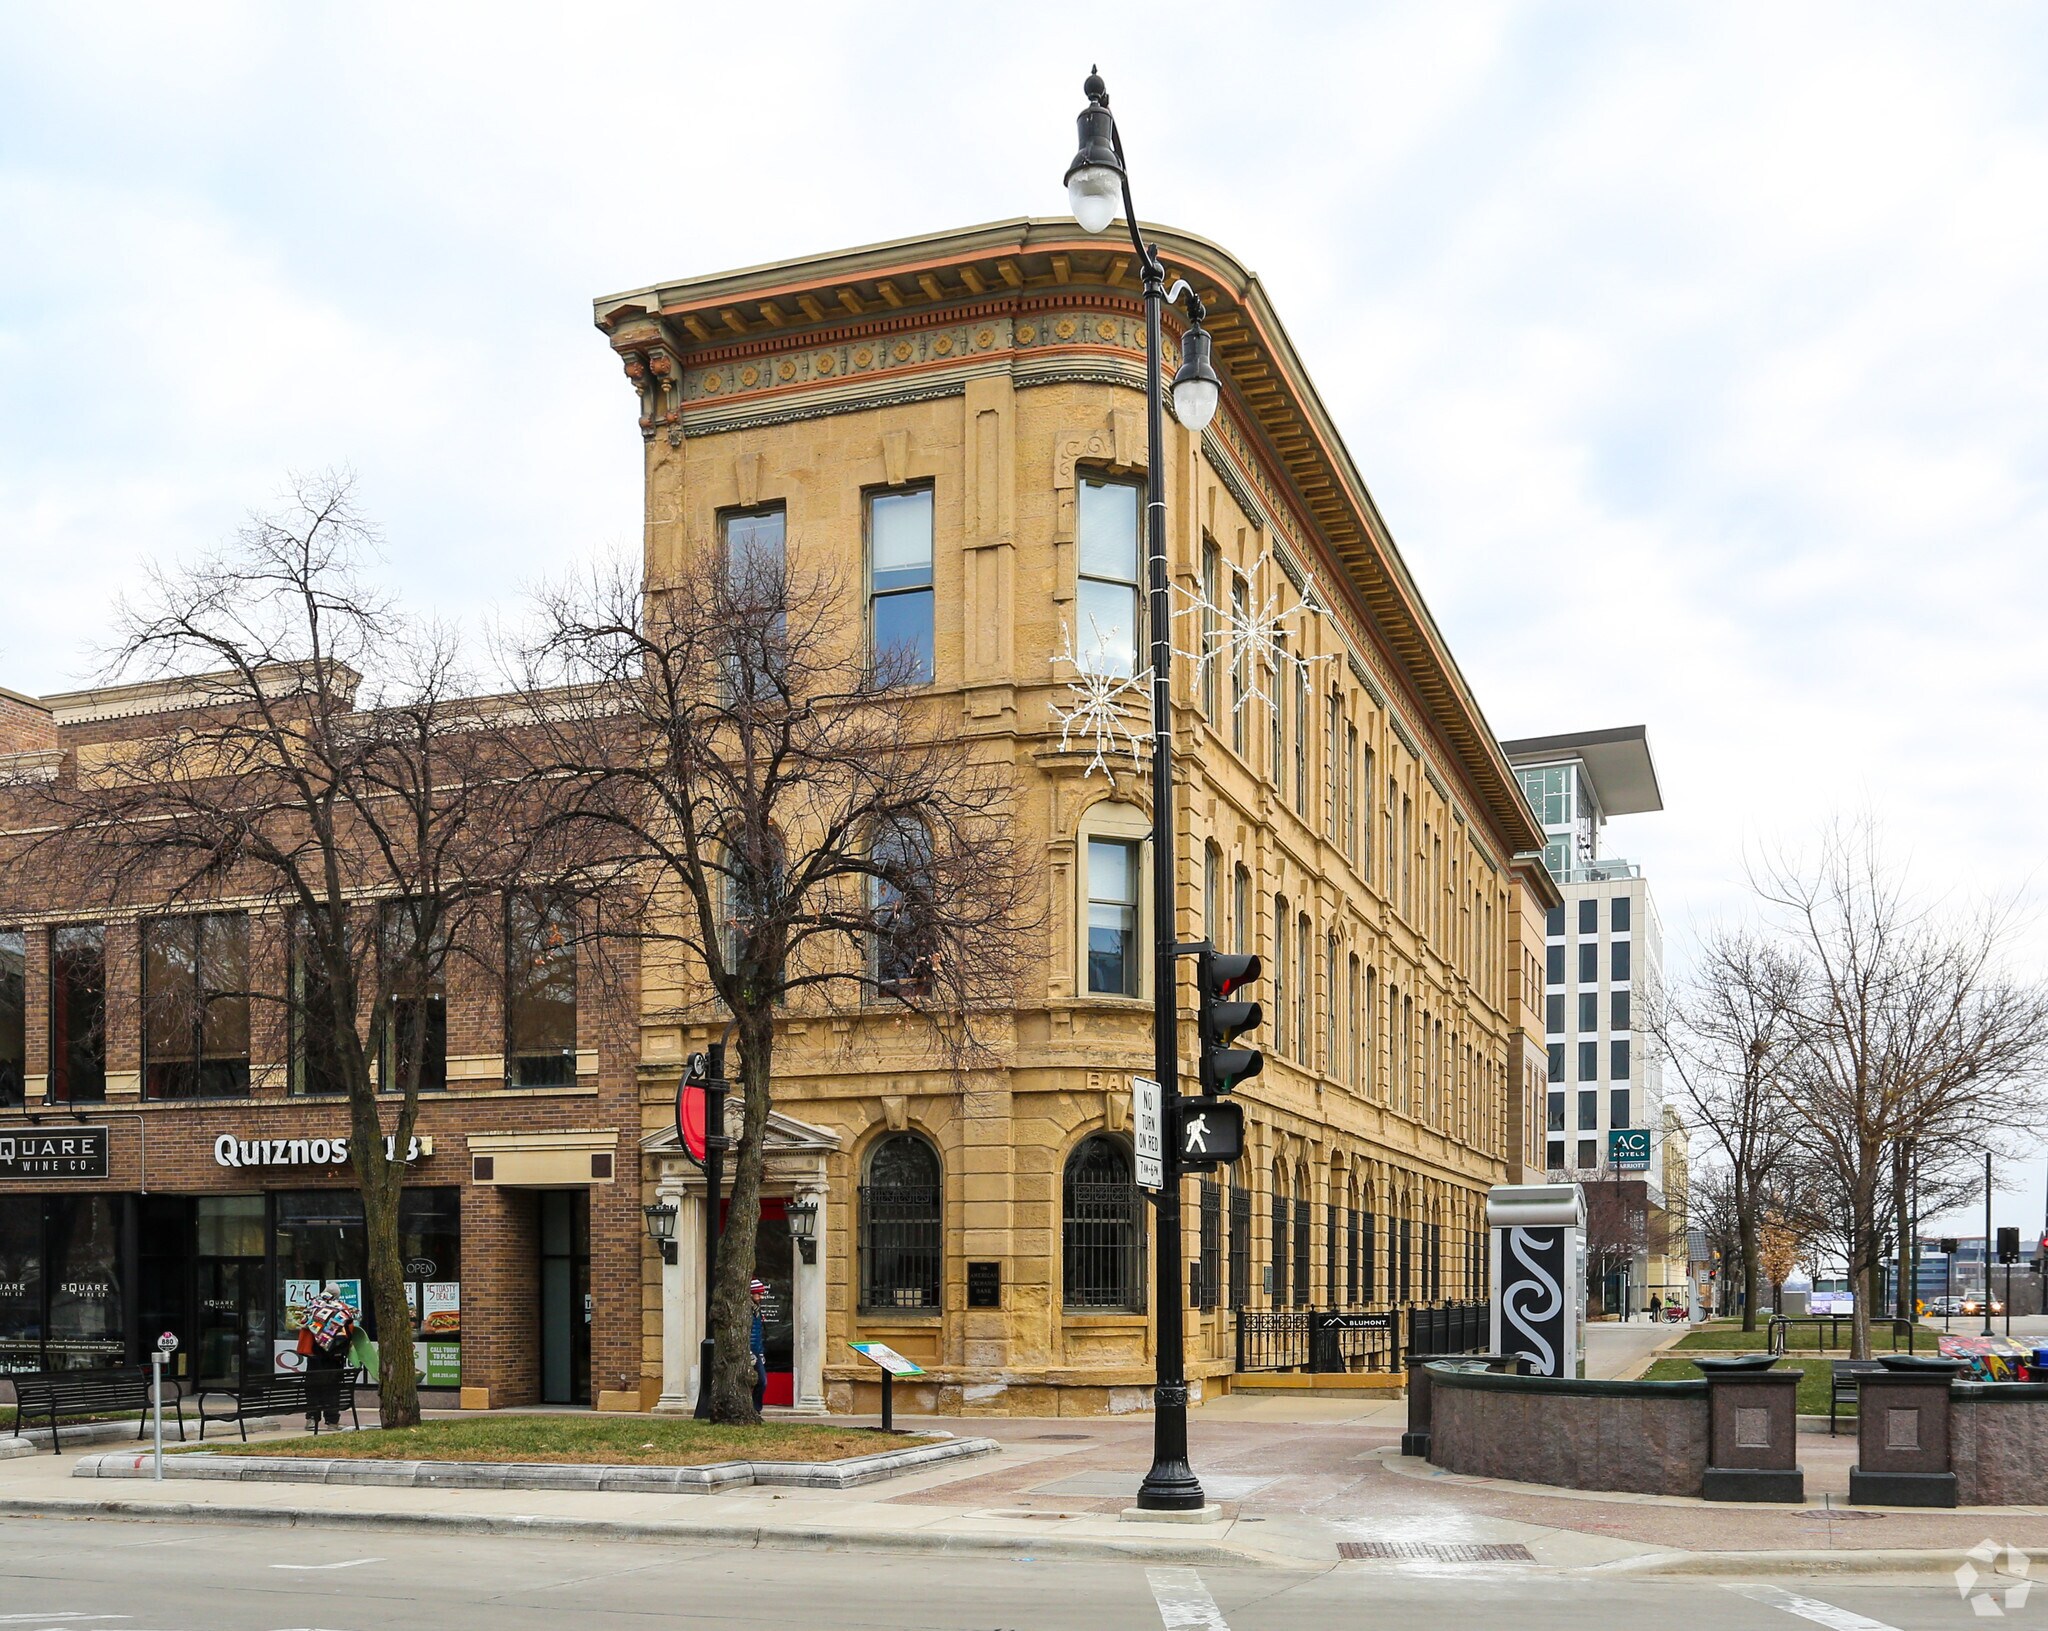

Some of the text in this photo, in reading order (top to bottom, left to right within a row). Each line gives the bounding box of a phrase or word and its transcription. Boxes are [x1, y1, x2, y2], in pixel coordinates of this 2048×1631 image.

[1087, 1073, 1134, 1092] BAN
[1143, 1091, 1153, 1111] NO
[1142, 1114, 1155, 1132] TURN
[1139, 1133, 1159, 1152] ON RED
[1613, 1134, 1645, 1150] AC
[22, 1160, 95, 1171] WINE CO.
[406, 1263, 433, 1274] OPEN
[61, 1283, 109, 1295] SQUARE
[289, 1284, 297, 1302] 2
[435, 1284, 456, 1293] TOASTY
[436, 1292, 450, 1301] DEAL
